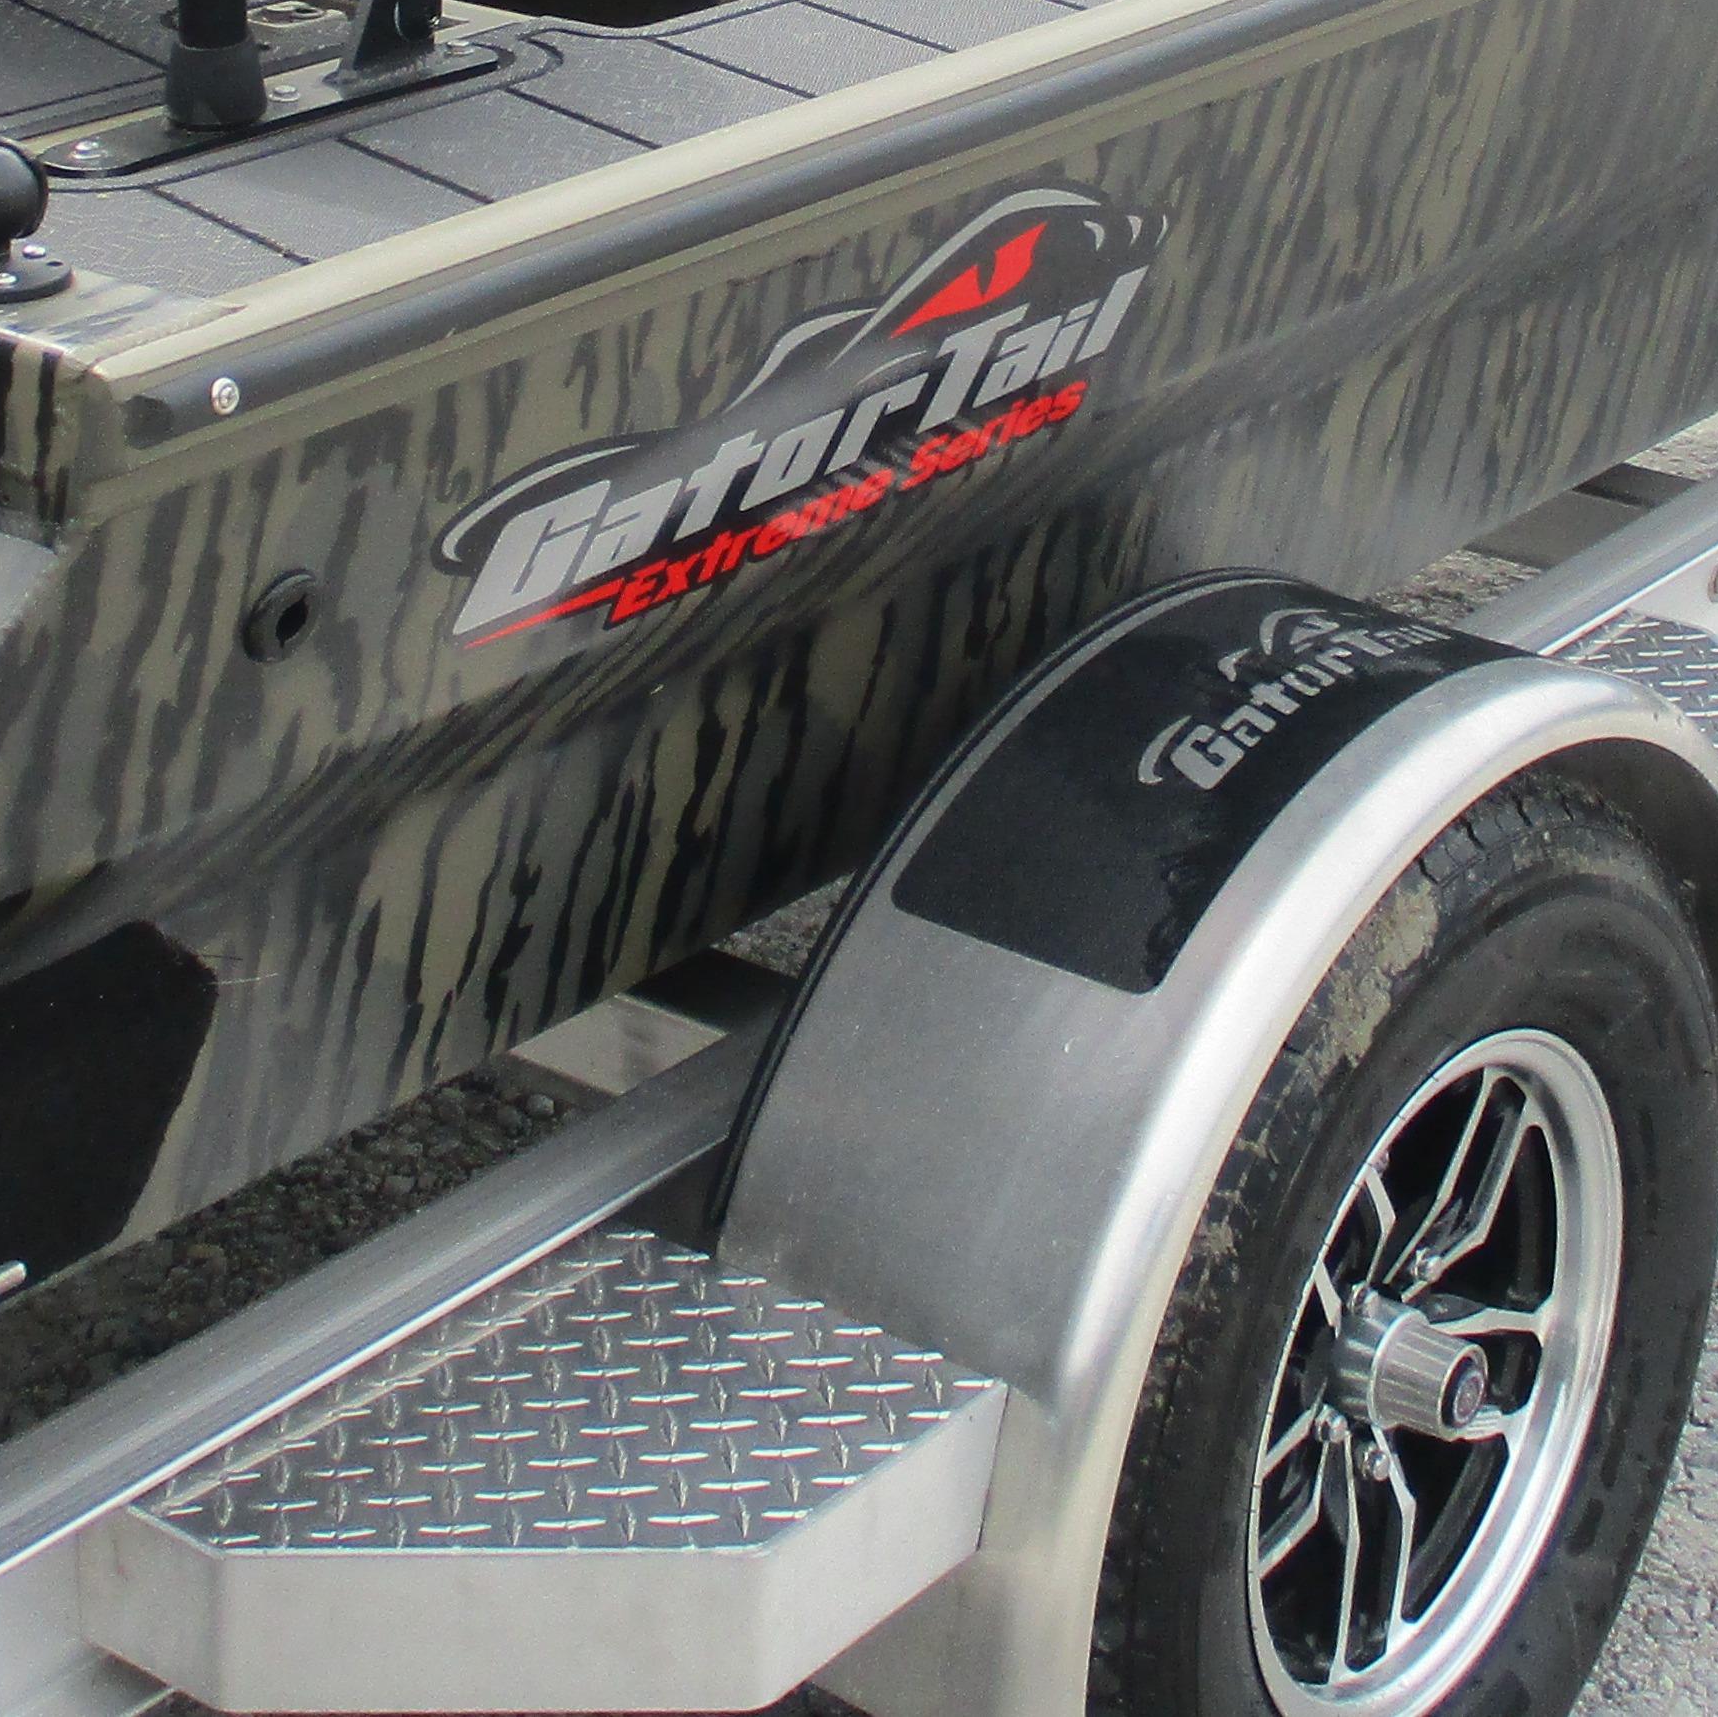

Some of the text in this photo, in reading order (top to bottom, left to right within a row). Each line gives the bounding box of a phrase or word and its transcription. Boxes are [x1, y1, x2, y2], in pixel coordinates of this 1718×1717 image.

[454, 265, 1149, 635] GatorTail
[609, 380, 1089, 625] Extreme Series
